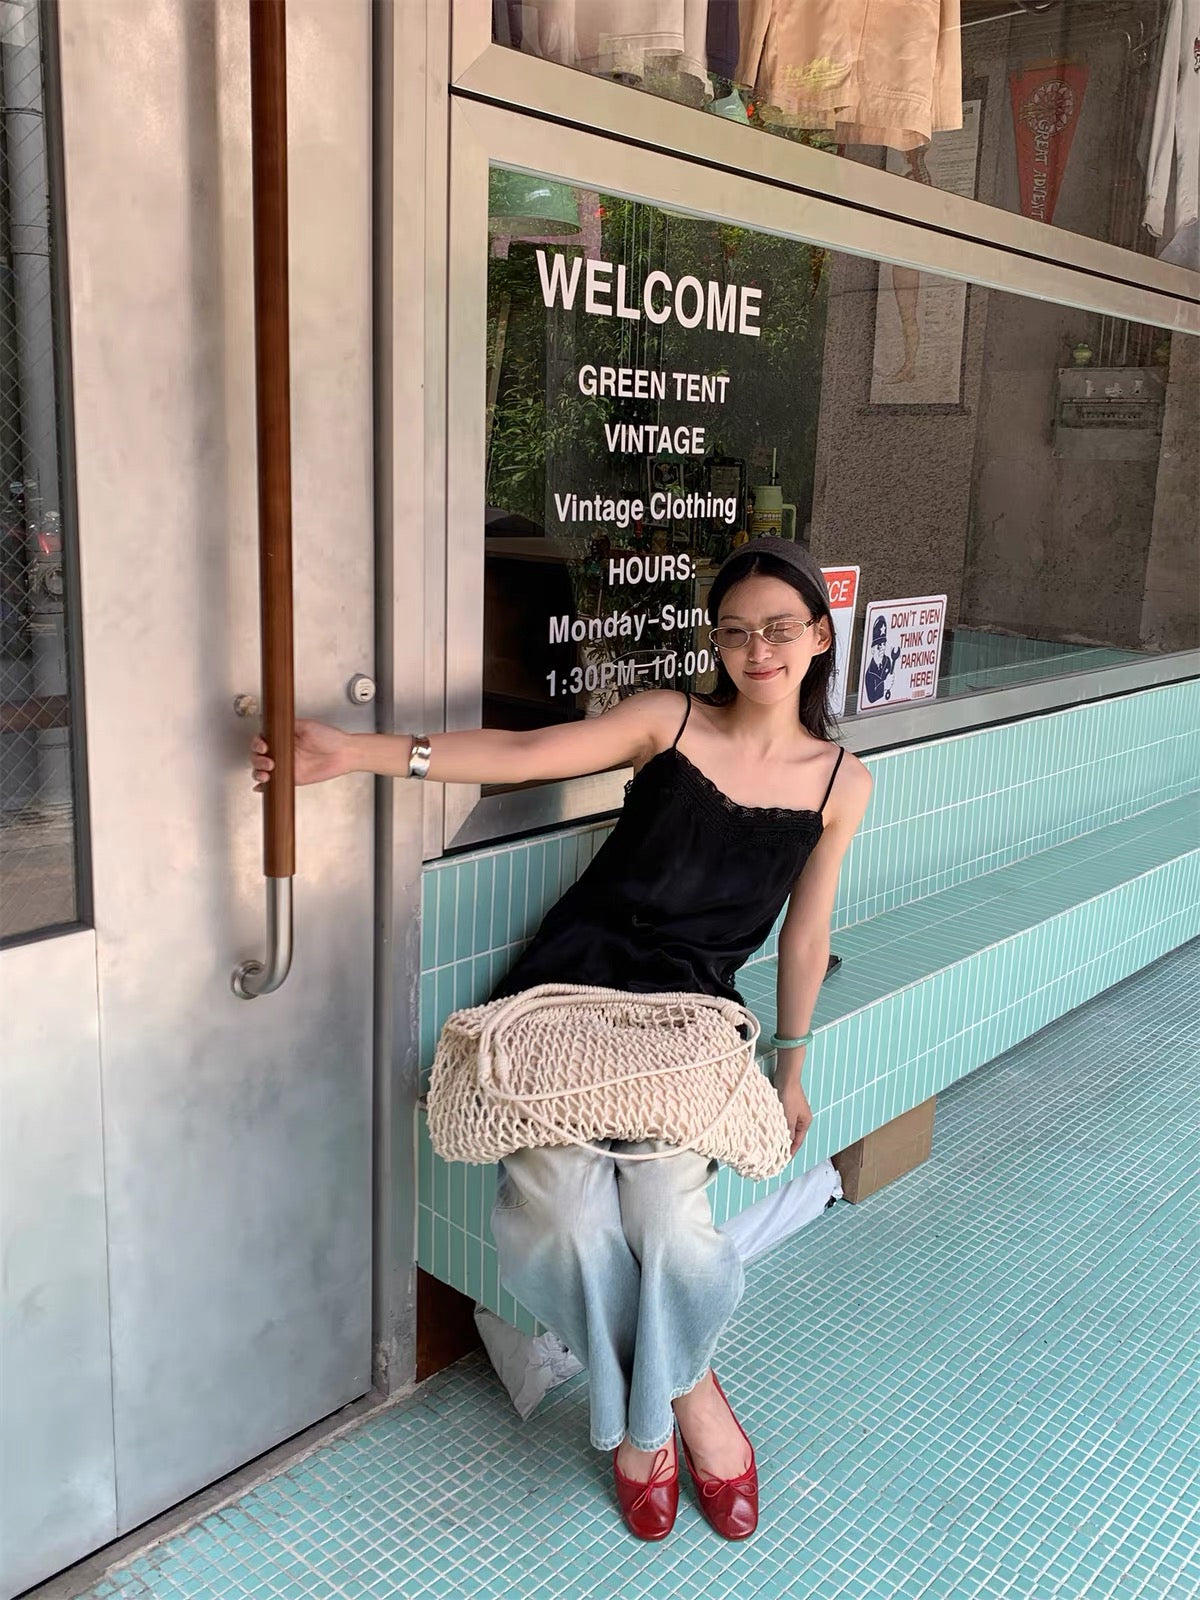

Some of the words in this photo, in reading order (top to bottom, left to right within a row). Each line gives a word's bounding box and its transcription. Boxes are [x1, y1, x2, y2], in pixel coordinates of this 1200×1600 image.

[1033, 119, 1049, 165] GREAT
[1031, 168, 1047, 221] ADVENT
[535, 249, 762, 337] WELCOME
[578, 364, 666, 400] GREEN
[672, 372, 730, 404] TENT
[604, 423, 706, 455] VINTAGE
[554, 492, 644, 528] Vintage
[650, 491, 737, 524] Clothing
[609, 553, 696, 586] HOURS:
[891, 610, 916, 629] DON'T
[920, 608, 940, 625] EVEN
[900, 631, 924, 648] THINK
[927, 629, 938, 645] OF
[901, 650, 935, 669] PARKING
[910, 671, 933, 688] HERE!
